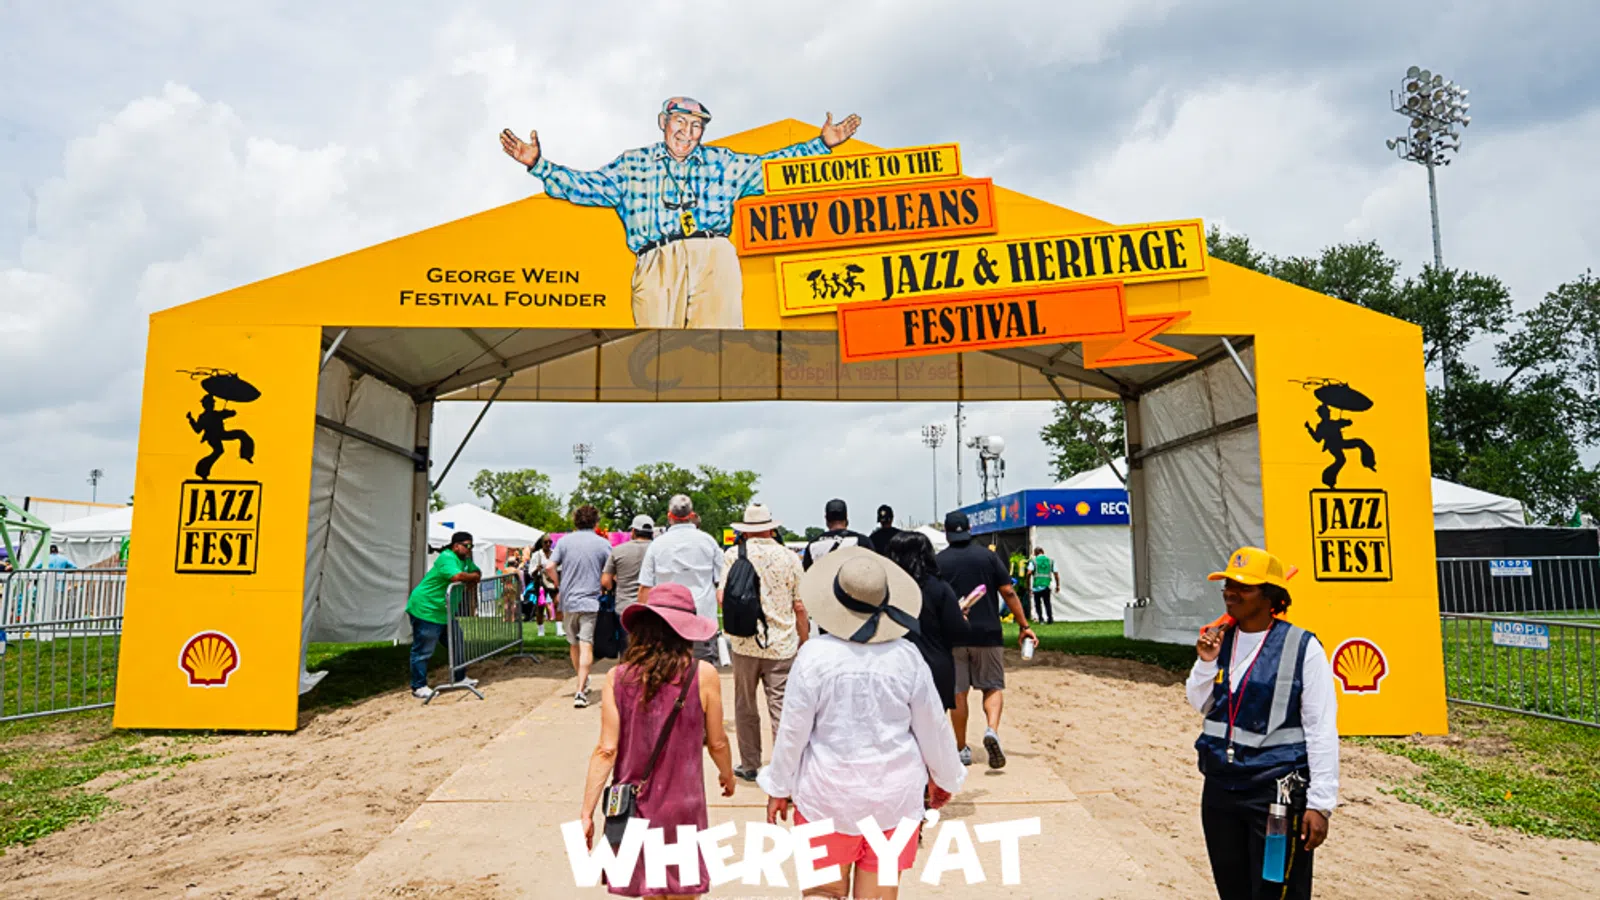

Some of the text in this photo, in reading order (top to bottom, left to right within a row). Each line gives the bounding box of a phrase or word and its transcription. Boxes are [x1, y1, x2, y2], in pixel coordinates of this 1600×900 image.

[782, 150, 944, 186] WELCOME TO THE
[749, 188, 981, 243] NEW ORLEANS
[427, 268, 580, 283] GEORGE WEIN
[881, 228, 1188, 302] JAZZ & HERITAGE
[400, 291, 607, 307] FESTIVAL FOUNDER
[903, 300, 1047, 347] FESTIVAL
[186, 489, 254, 527] JAZZ
[1318, 497, 1383, 535] JAZZ
[184, 532, 254, 566] FEST
[1320, 540, 1385, 573] FEST
